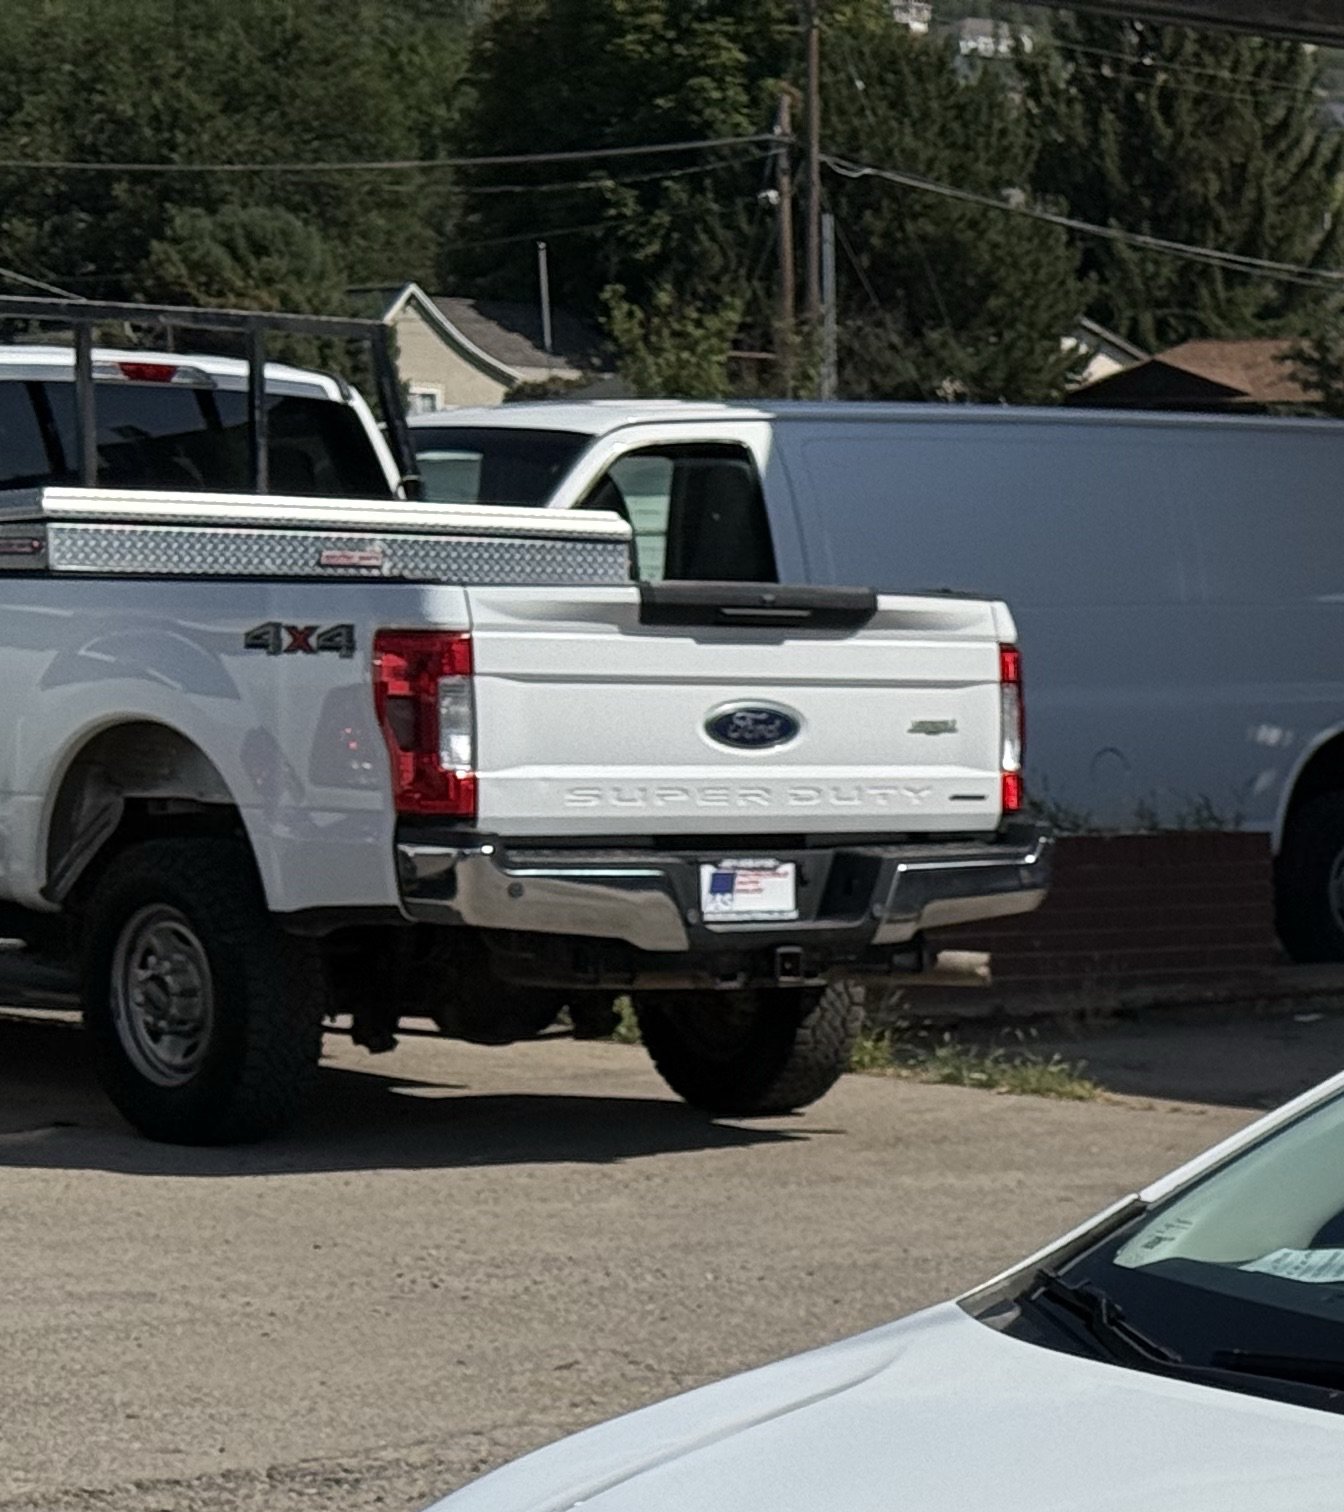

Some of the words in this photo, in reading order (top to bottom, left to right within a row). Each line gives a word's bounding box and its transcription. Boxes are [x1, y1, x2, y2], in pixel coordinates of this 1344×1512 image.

[727, 711, 781, 739] Ford
[564, 786, 773, 807] SUPER
[786, 785, 934, 807] DUTY
